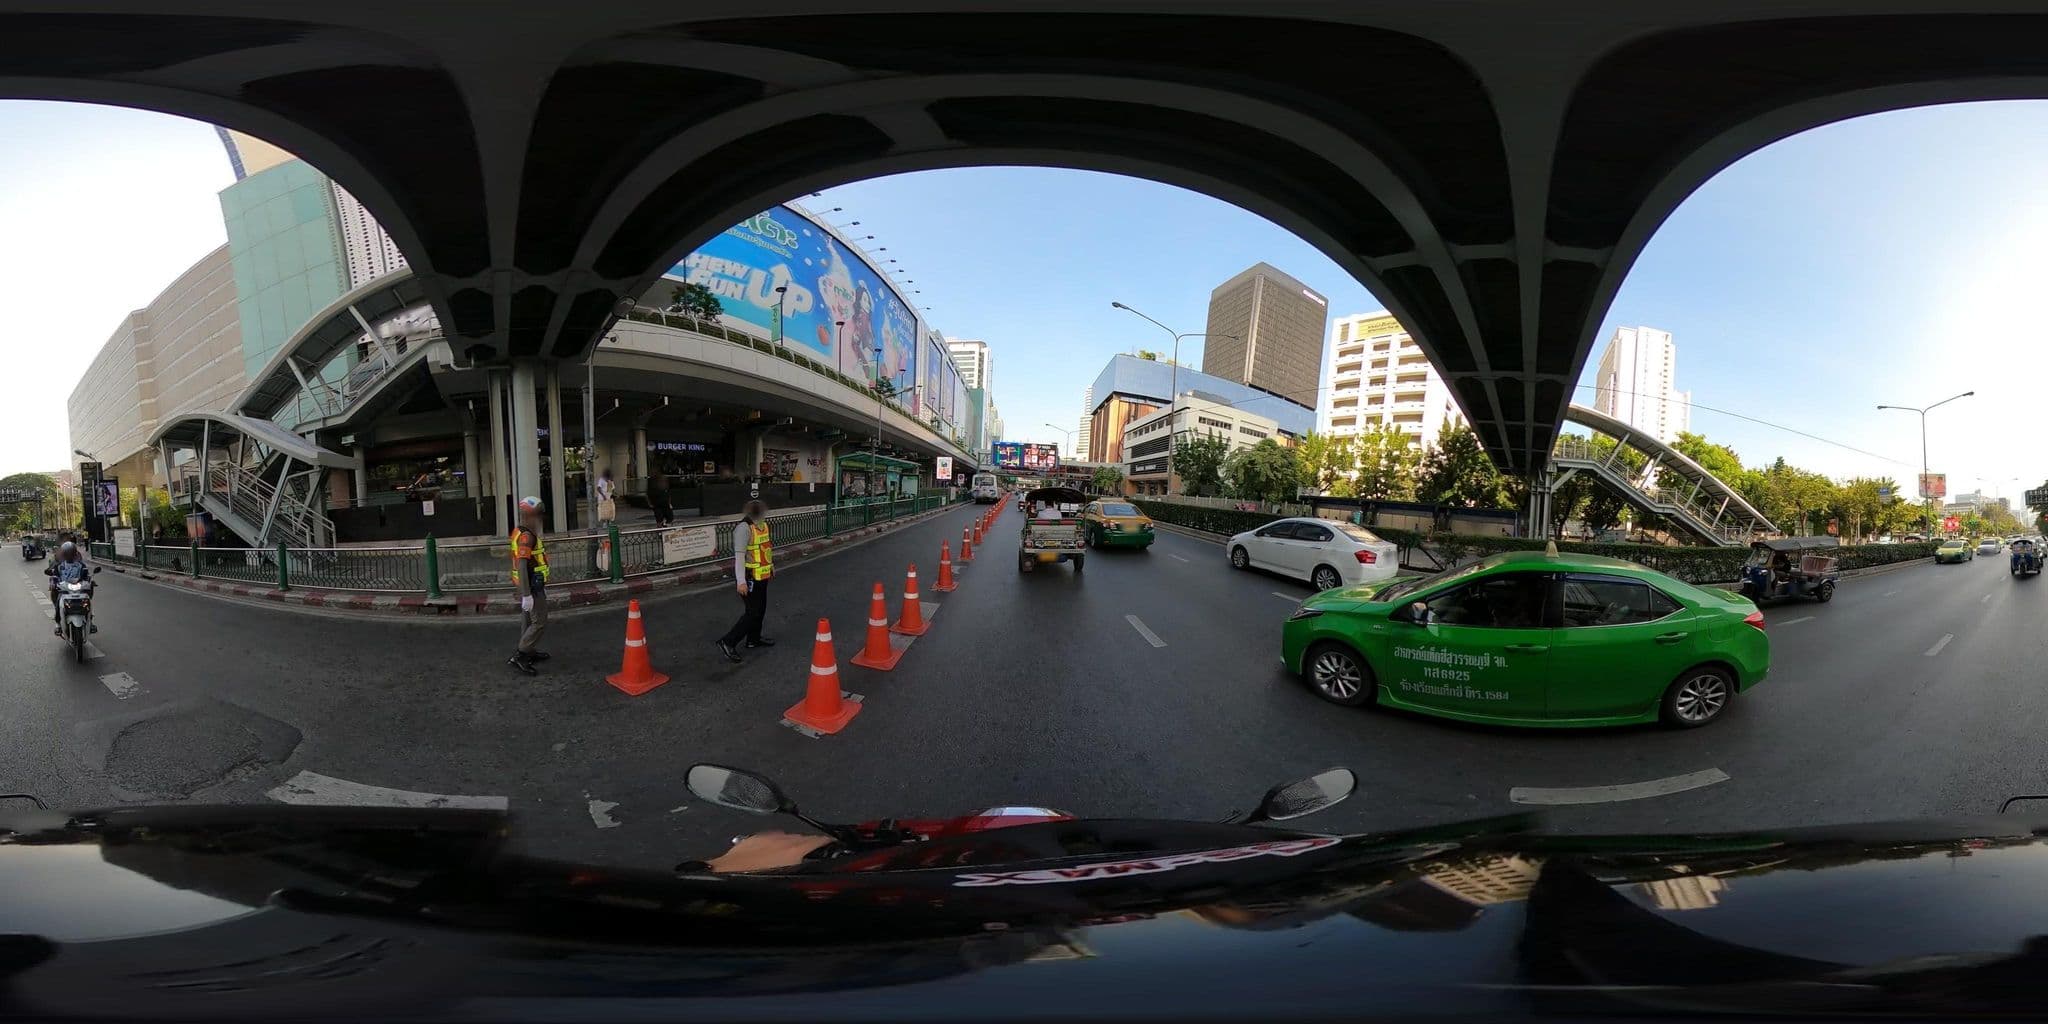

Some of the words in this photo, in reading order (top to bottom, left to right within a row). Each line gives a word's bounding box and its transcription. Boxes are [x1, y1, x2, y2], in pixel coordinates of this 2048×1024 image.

[749, 263, 814, 318] UP
[657, 442, 687, 451] BURGER
[688, 443, 705, 452] KING
